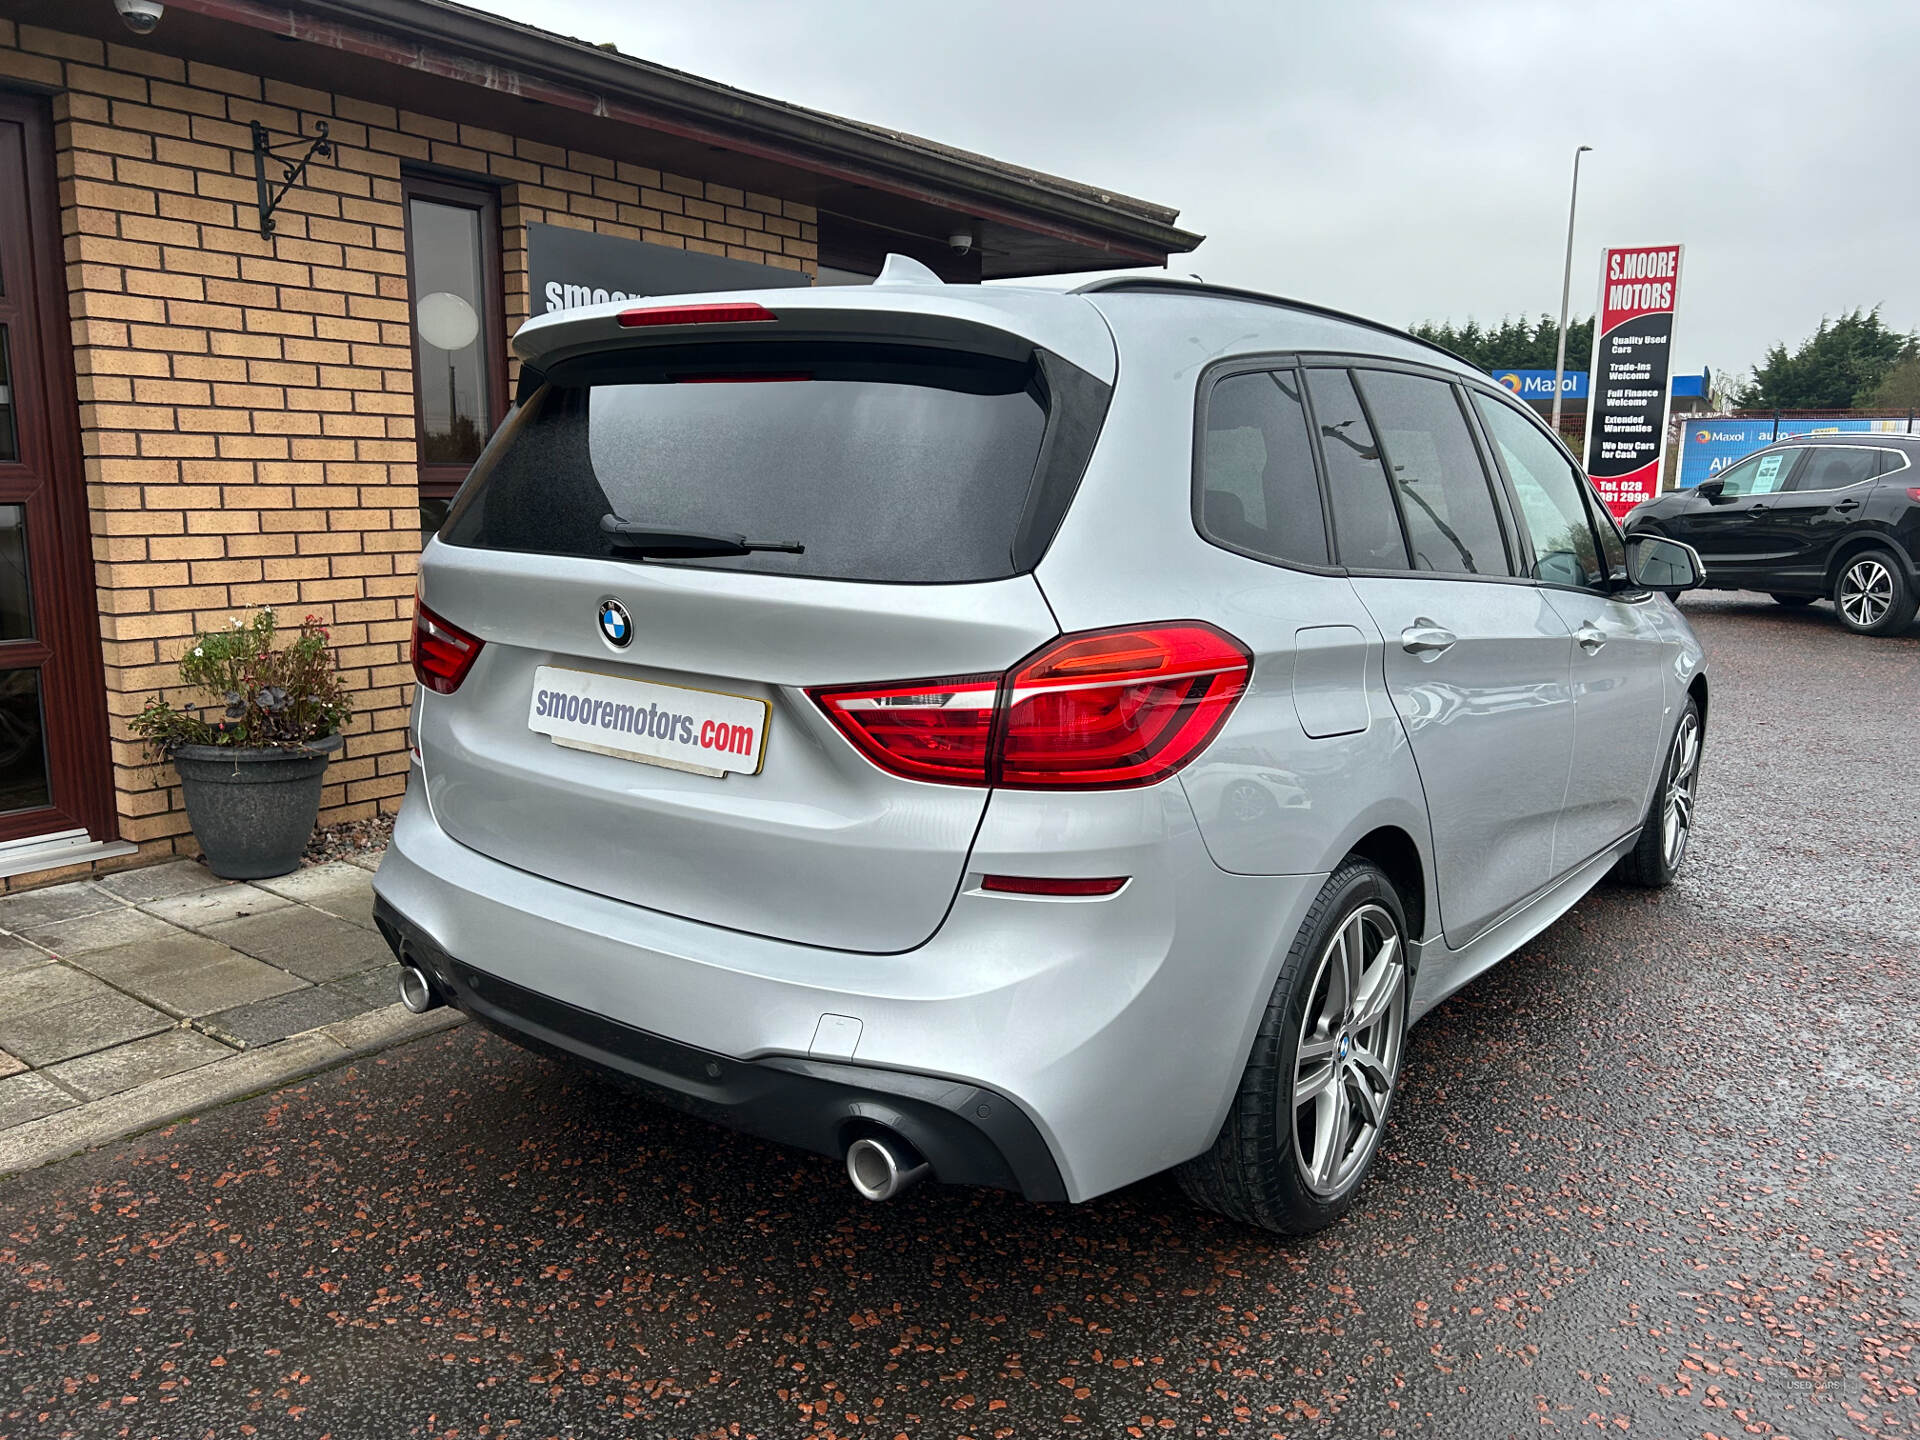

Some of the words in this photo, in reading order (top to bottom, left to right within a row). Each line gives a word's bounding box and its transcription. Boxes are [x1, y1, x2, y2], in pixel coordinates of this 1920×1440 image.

[1610, 251, 1676, 280] S.MOORE
[1608, 282, 1672, 310] MOTORS
[1612, 336, 1644, 345] Quality
[1645, 335, 1667, 343] Used
[1612, 345, 1632, 353] Cars
[1609, 371, 1650, 380] Welcome
[1607, 389, 1623, 397] Full
[1624, 389, 1658, 397] Finance
[1606, 398, 1647, 406] Welcome
[1605, 415, 1644, 424] Extended
[1712, 432, 1744, 441] Maxol
[1602, 442, 1616, 450] We
[1617, 442, 1634, 451] buy
[1634, 441, 1655, 449] Cars
[1615, 450, 1637, 458] Cash
[1620, 481, 1643, 491] 028
[1620, 492, 1650, 502] 2999
[600, 602, 627, 618] BMW
[536, 689, 754, 756] smooremotors.com
